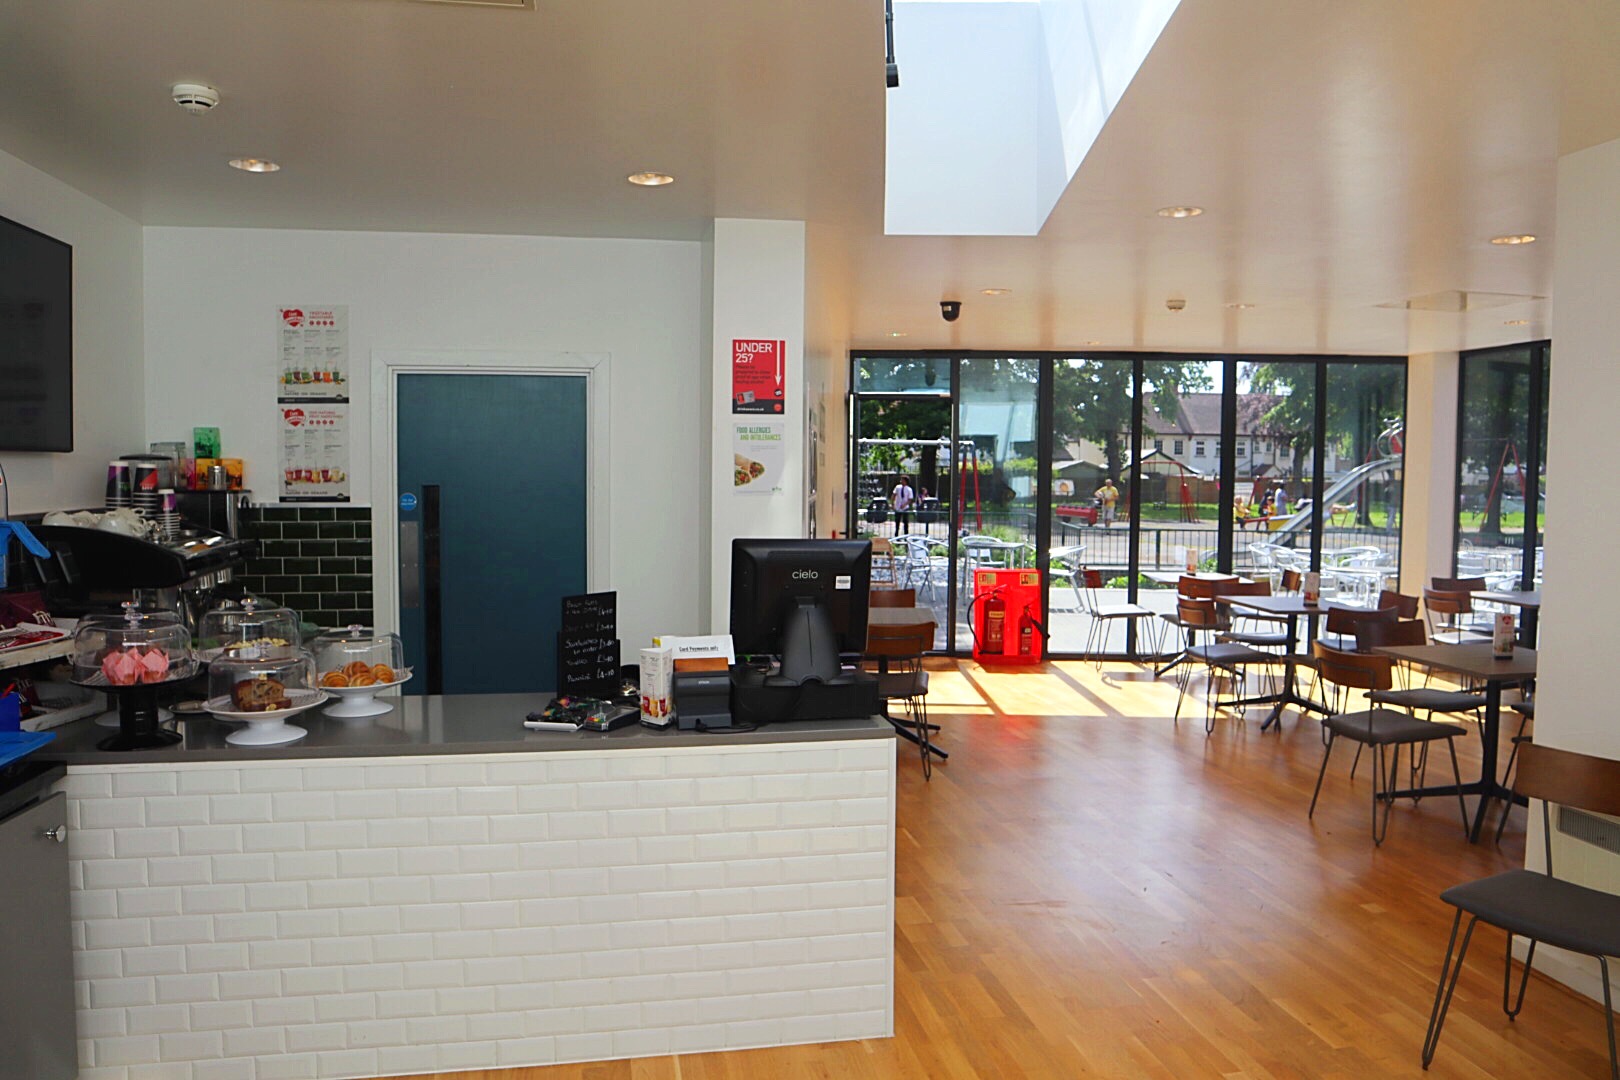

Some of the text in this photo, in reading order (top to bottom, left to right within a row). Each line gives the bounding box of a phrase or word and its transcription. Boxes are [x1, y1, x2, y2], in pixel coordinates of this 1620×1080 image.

[735, 342, 773, 353] UNDER
[735, 353, 754, 363] 25?
[791, 569, 819, 579] cielo
